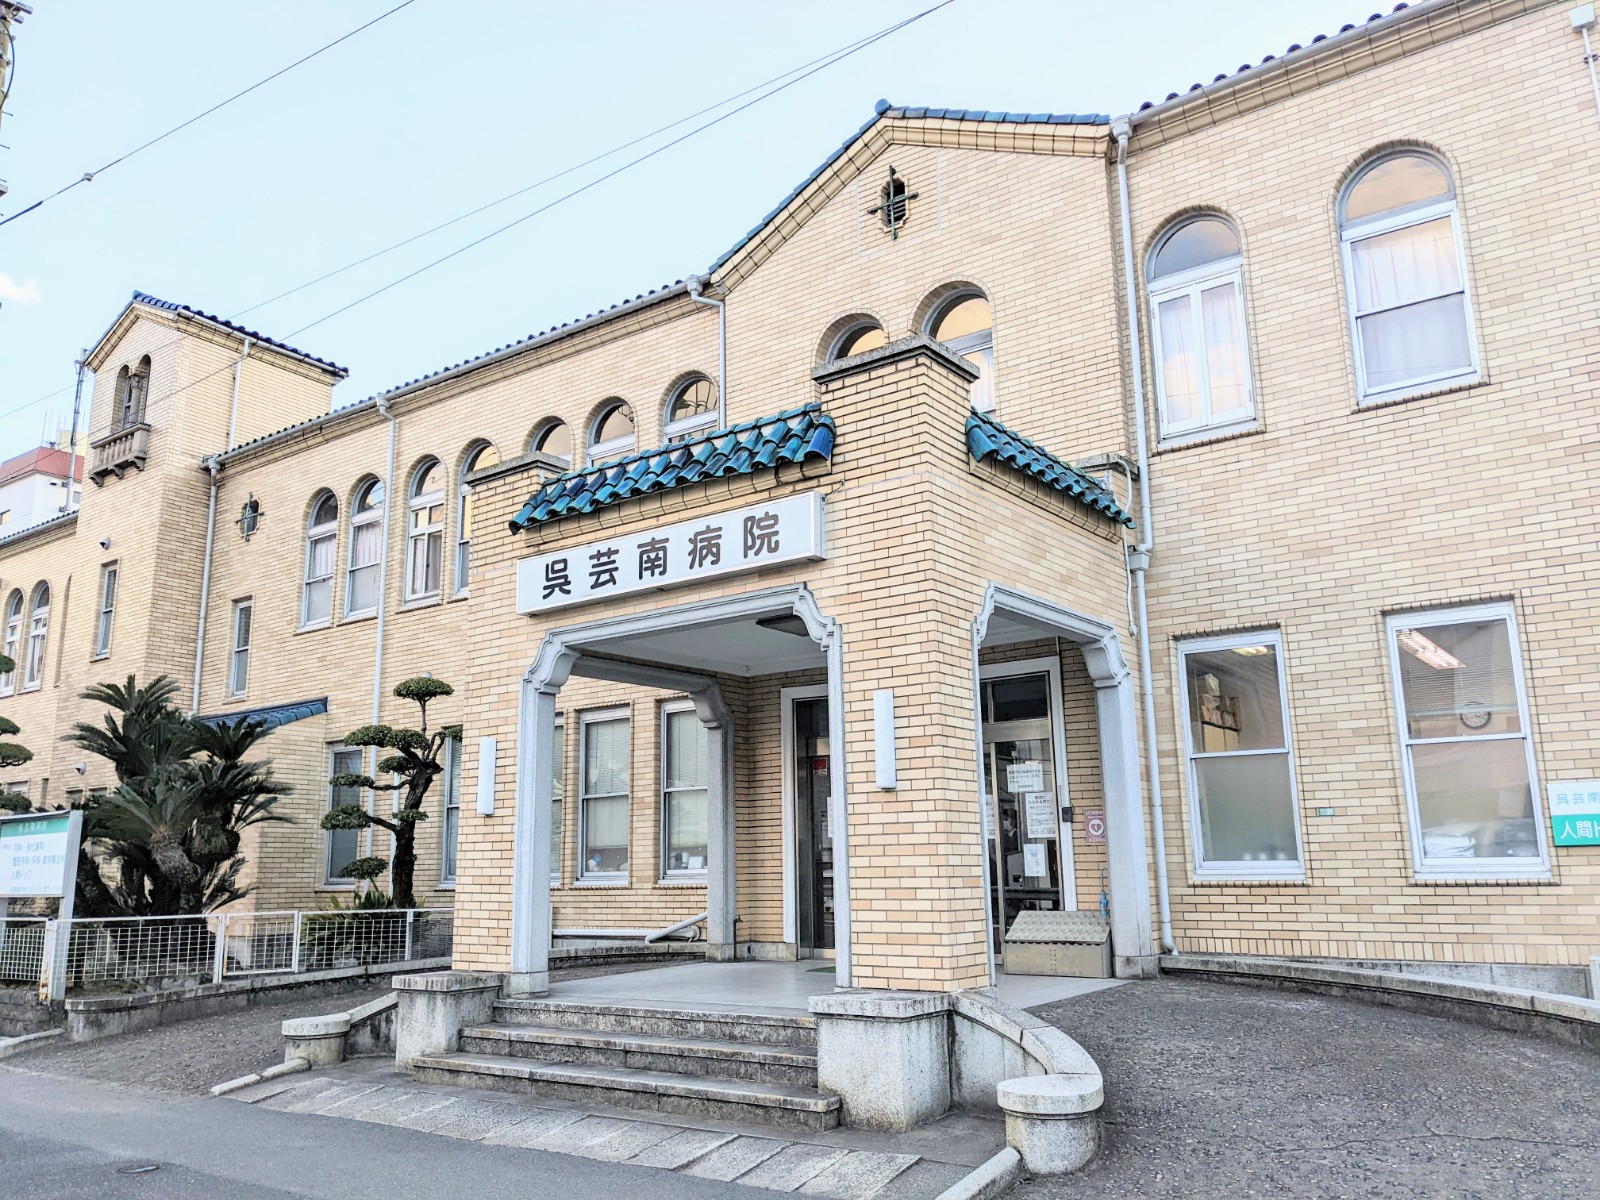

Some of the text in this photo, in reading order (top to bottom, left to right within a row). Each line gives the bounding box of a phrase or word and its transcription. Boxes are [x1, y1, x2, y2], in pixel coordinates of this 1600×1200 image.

[541, 511, 781, 600] 呉芸南病院
[1556, 791, 1600, 805] 呉芸南
